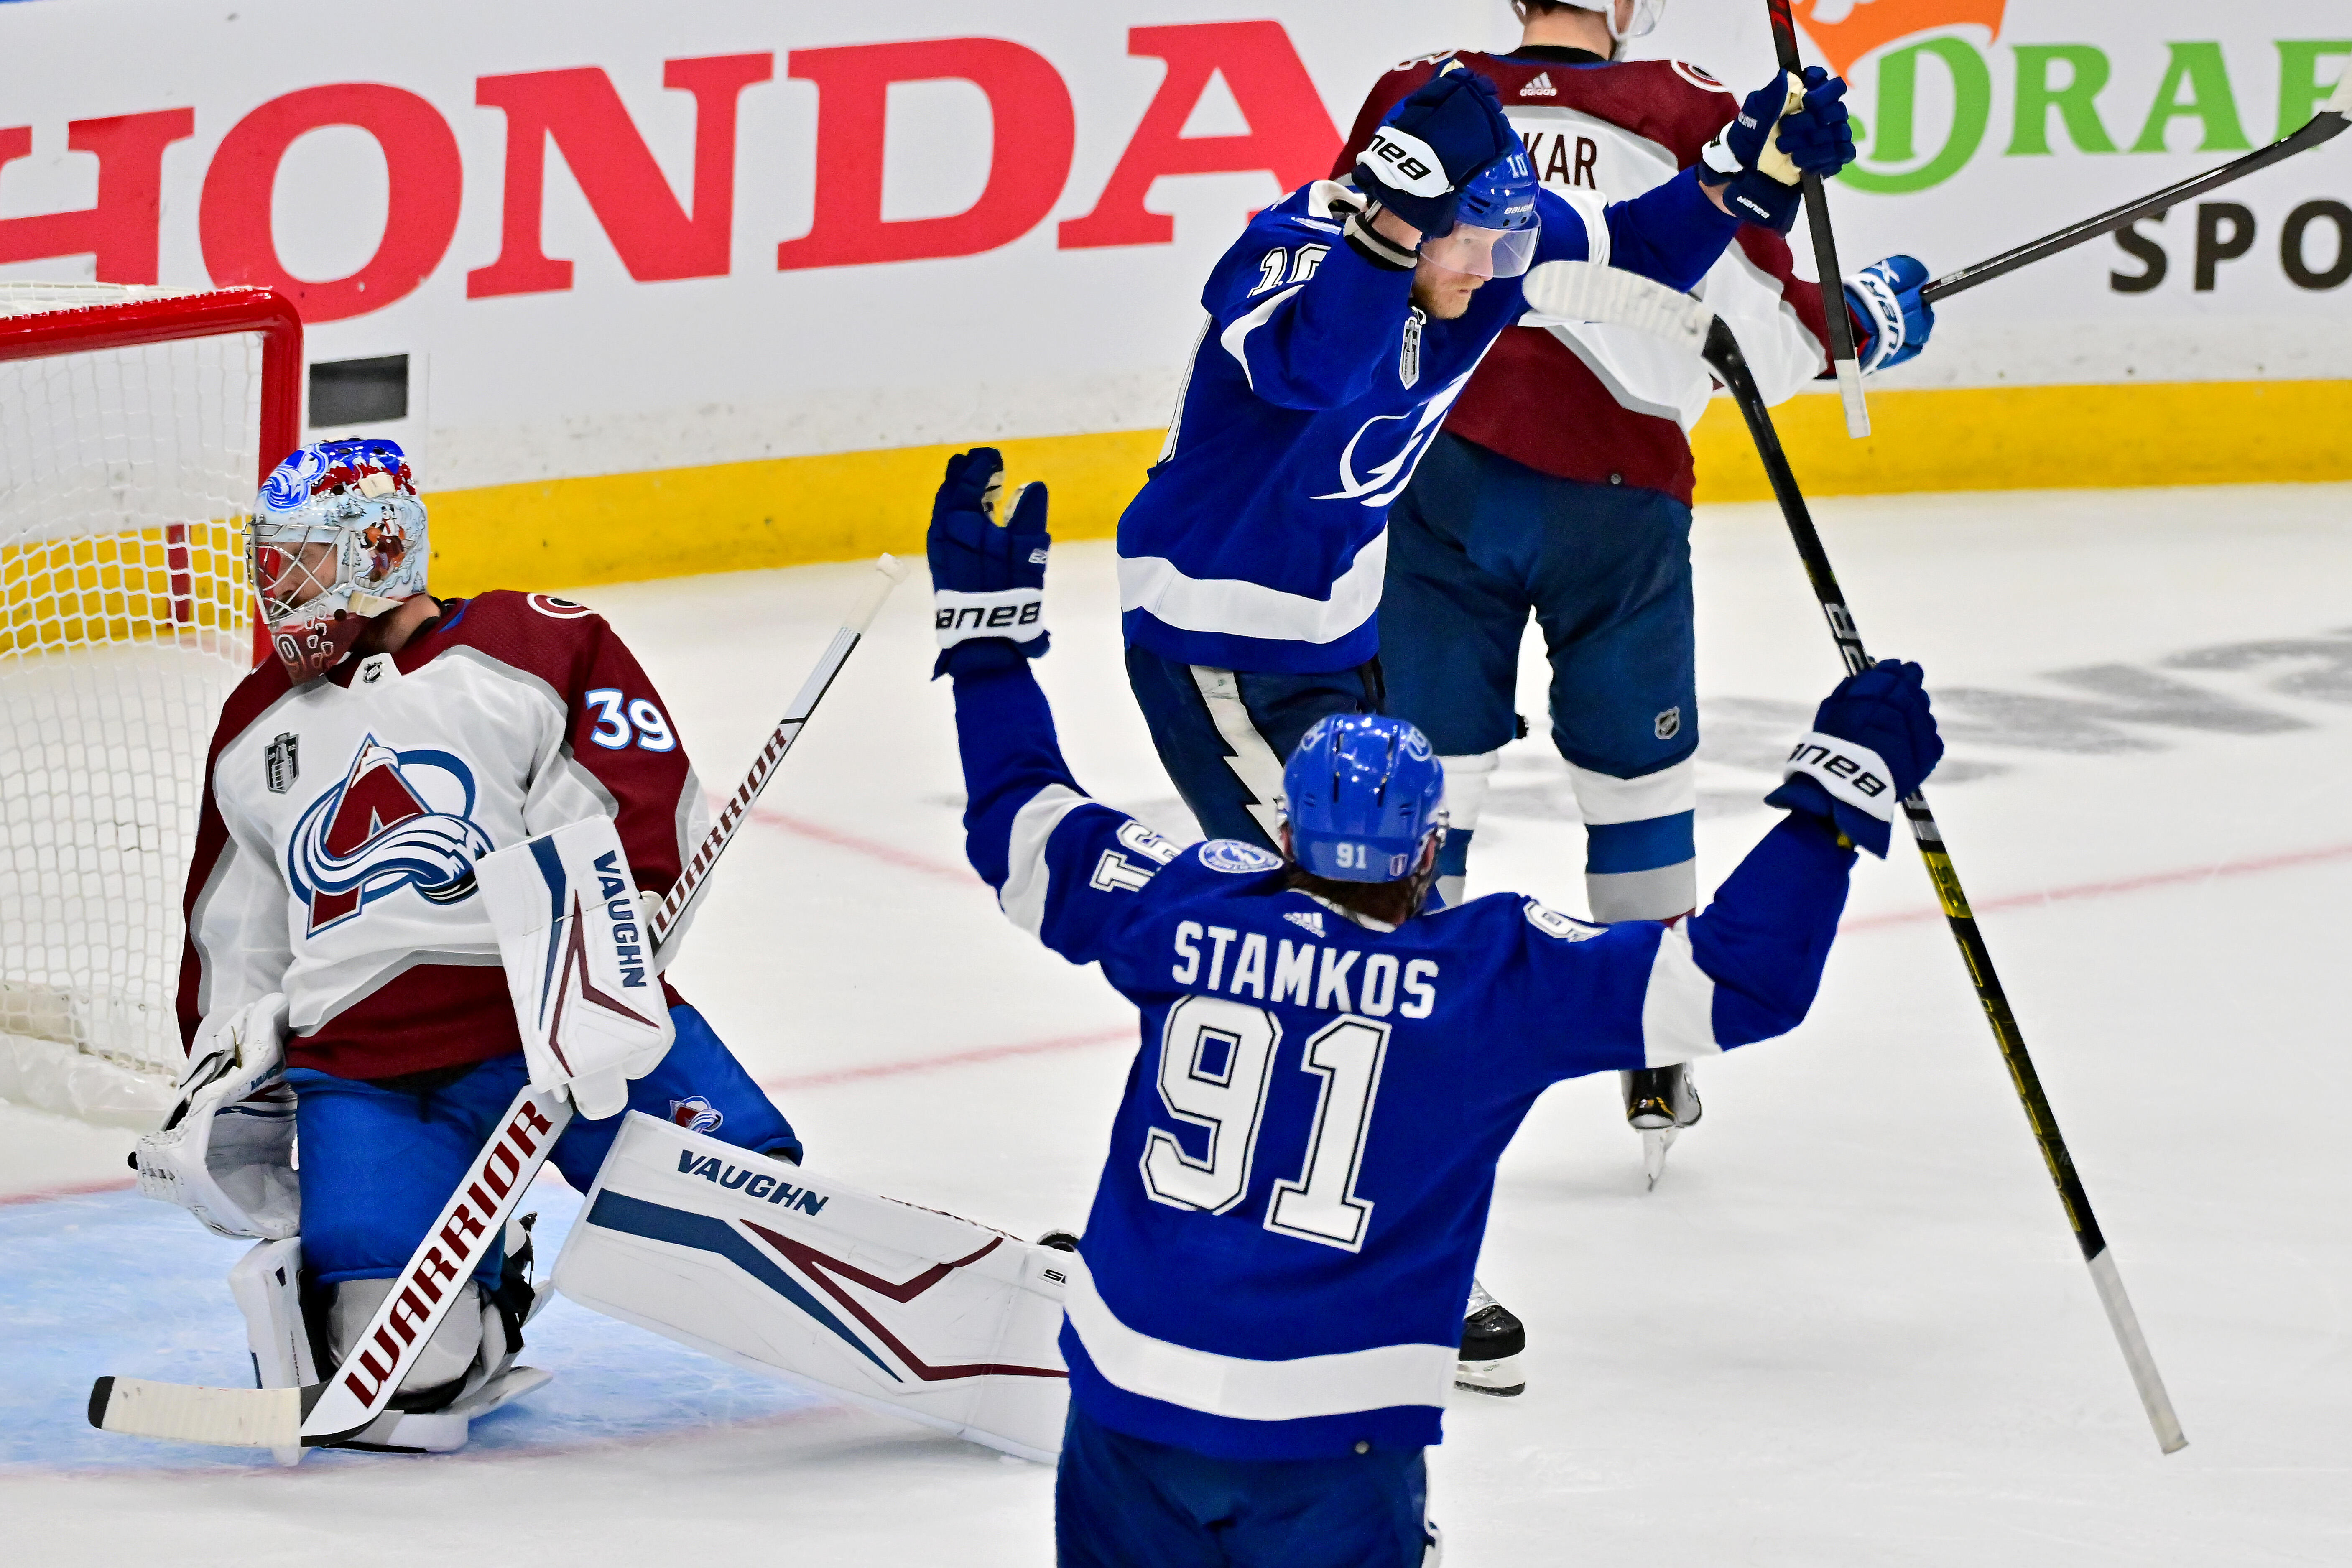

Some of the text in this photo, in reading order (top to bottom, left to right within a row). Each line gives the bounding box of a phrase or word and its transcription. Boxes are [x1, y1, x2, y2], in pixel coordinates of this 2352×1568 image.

[0, 20, 1347, 324] HONDA
[1507, 152, 1528, 178] 10
[585, 688, 676, 752] 39
[1788, 743, 1887, 797] BAU
[655, 728, 787, 933] WARRIOR
[1336, 842, 1367, 869] 91
[593, 850, 647, 988] VAUGHN
[1172, 920, 1439, 1019] STAMKOS
[1139, 995, 1392, 1254] 91
[678, 1149, 829, 1216] VAUGHN
[344, 1100, 553, 1409] WARRIOR
